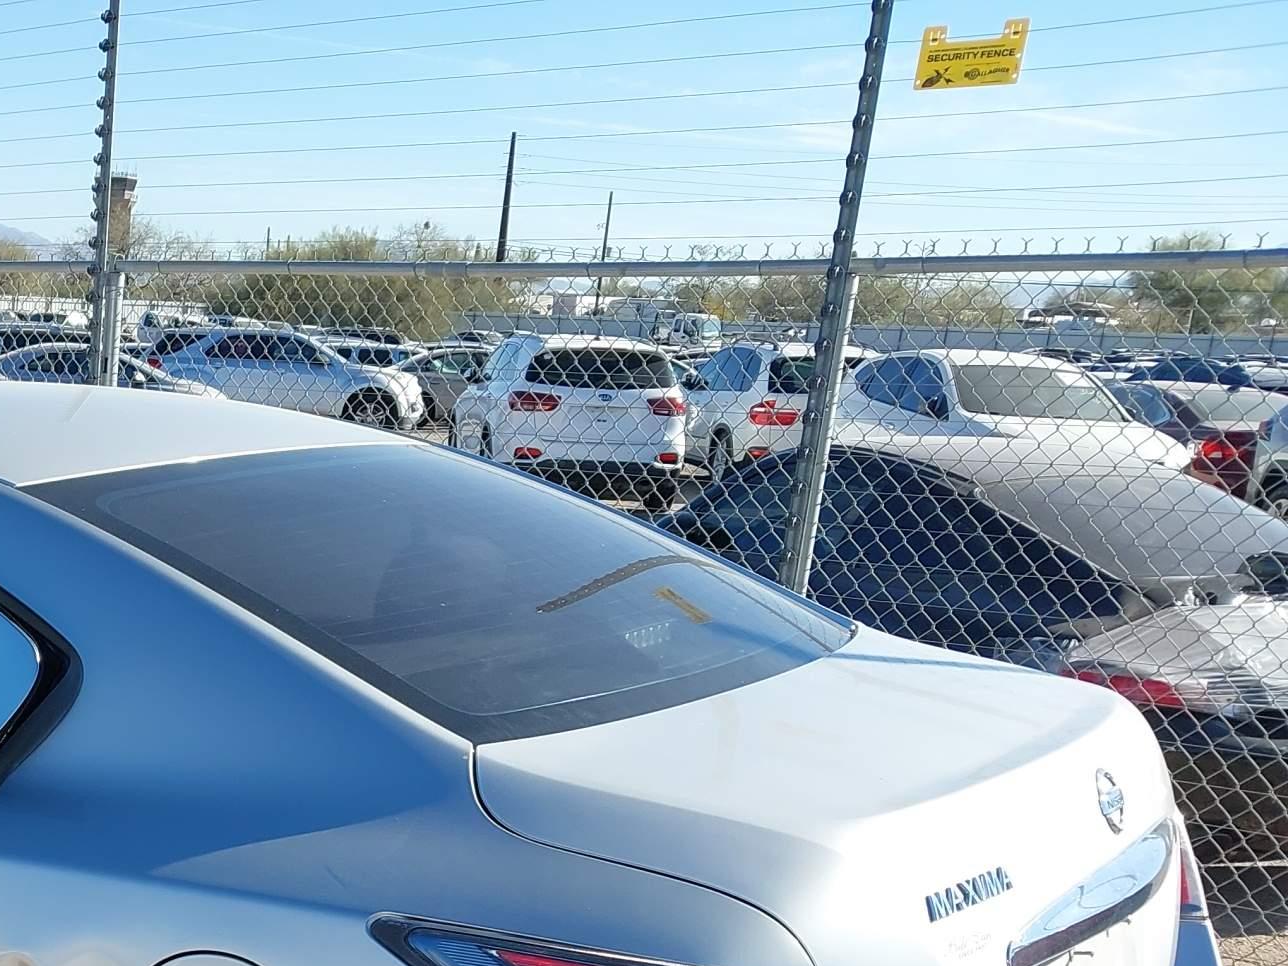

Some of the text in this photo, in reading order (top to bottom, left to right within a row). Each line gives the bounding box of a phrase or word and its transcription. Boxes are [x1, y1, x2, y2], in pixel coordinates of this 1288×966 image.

[927, 51, 980, 62] SECURITY
[980, 48, 1016, 58] FENCE
[925, 866, 1013, 923] MAXIMA
